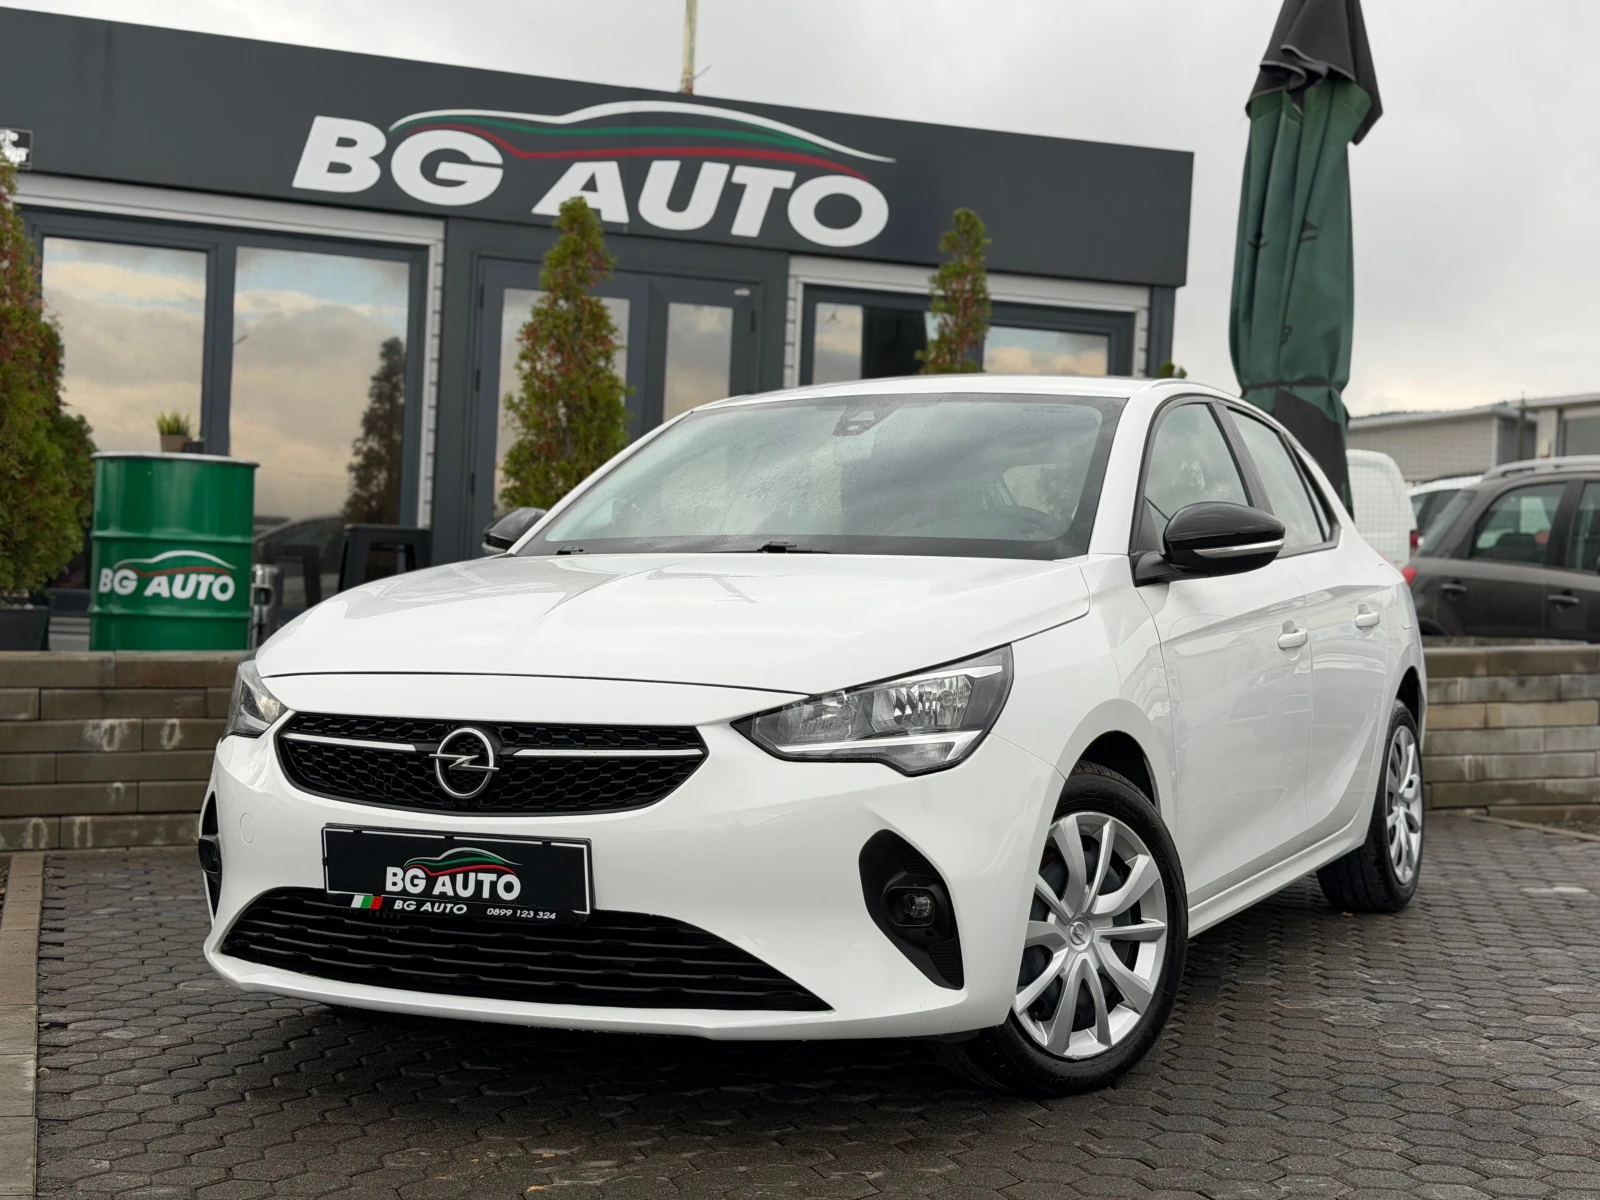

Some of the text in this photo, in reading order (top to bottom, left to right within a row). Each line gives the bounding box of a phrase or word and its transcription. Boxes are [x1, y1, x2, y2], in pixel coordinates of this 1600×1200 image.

[292, 115, 890, 248] BG AUTO
[98, 567, 236, 602] BG AUTO
[385, 866, 521, 901] BG AUTO
[393, 900, 467, 915] BG AUTO
[486, 907, 557, 920] 0899 123 324
